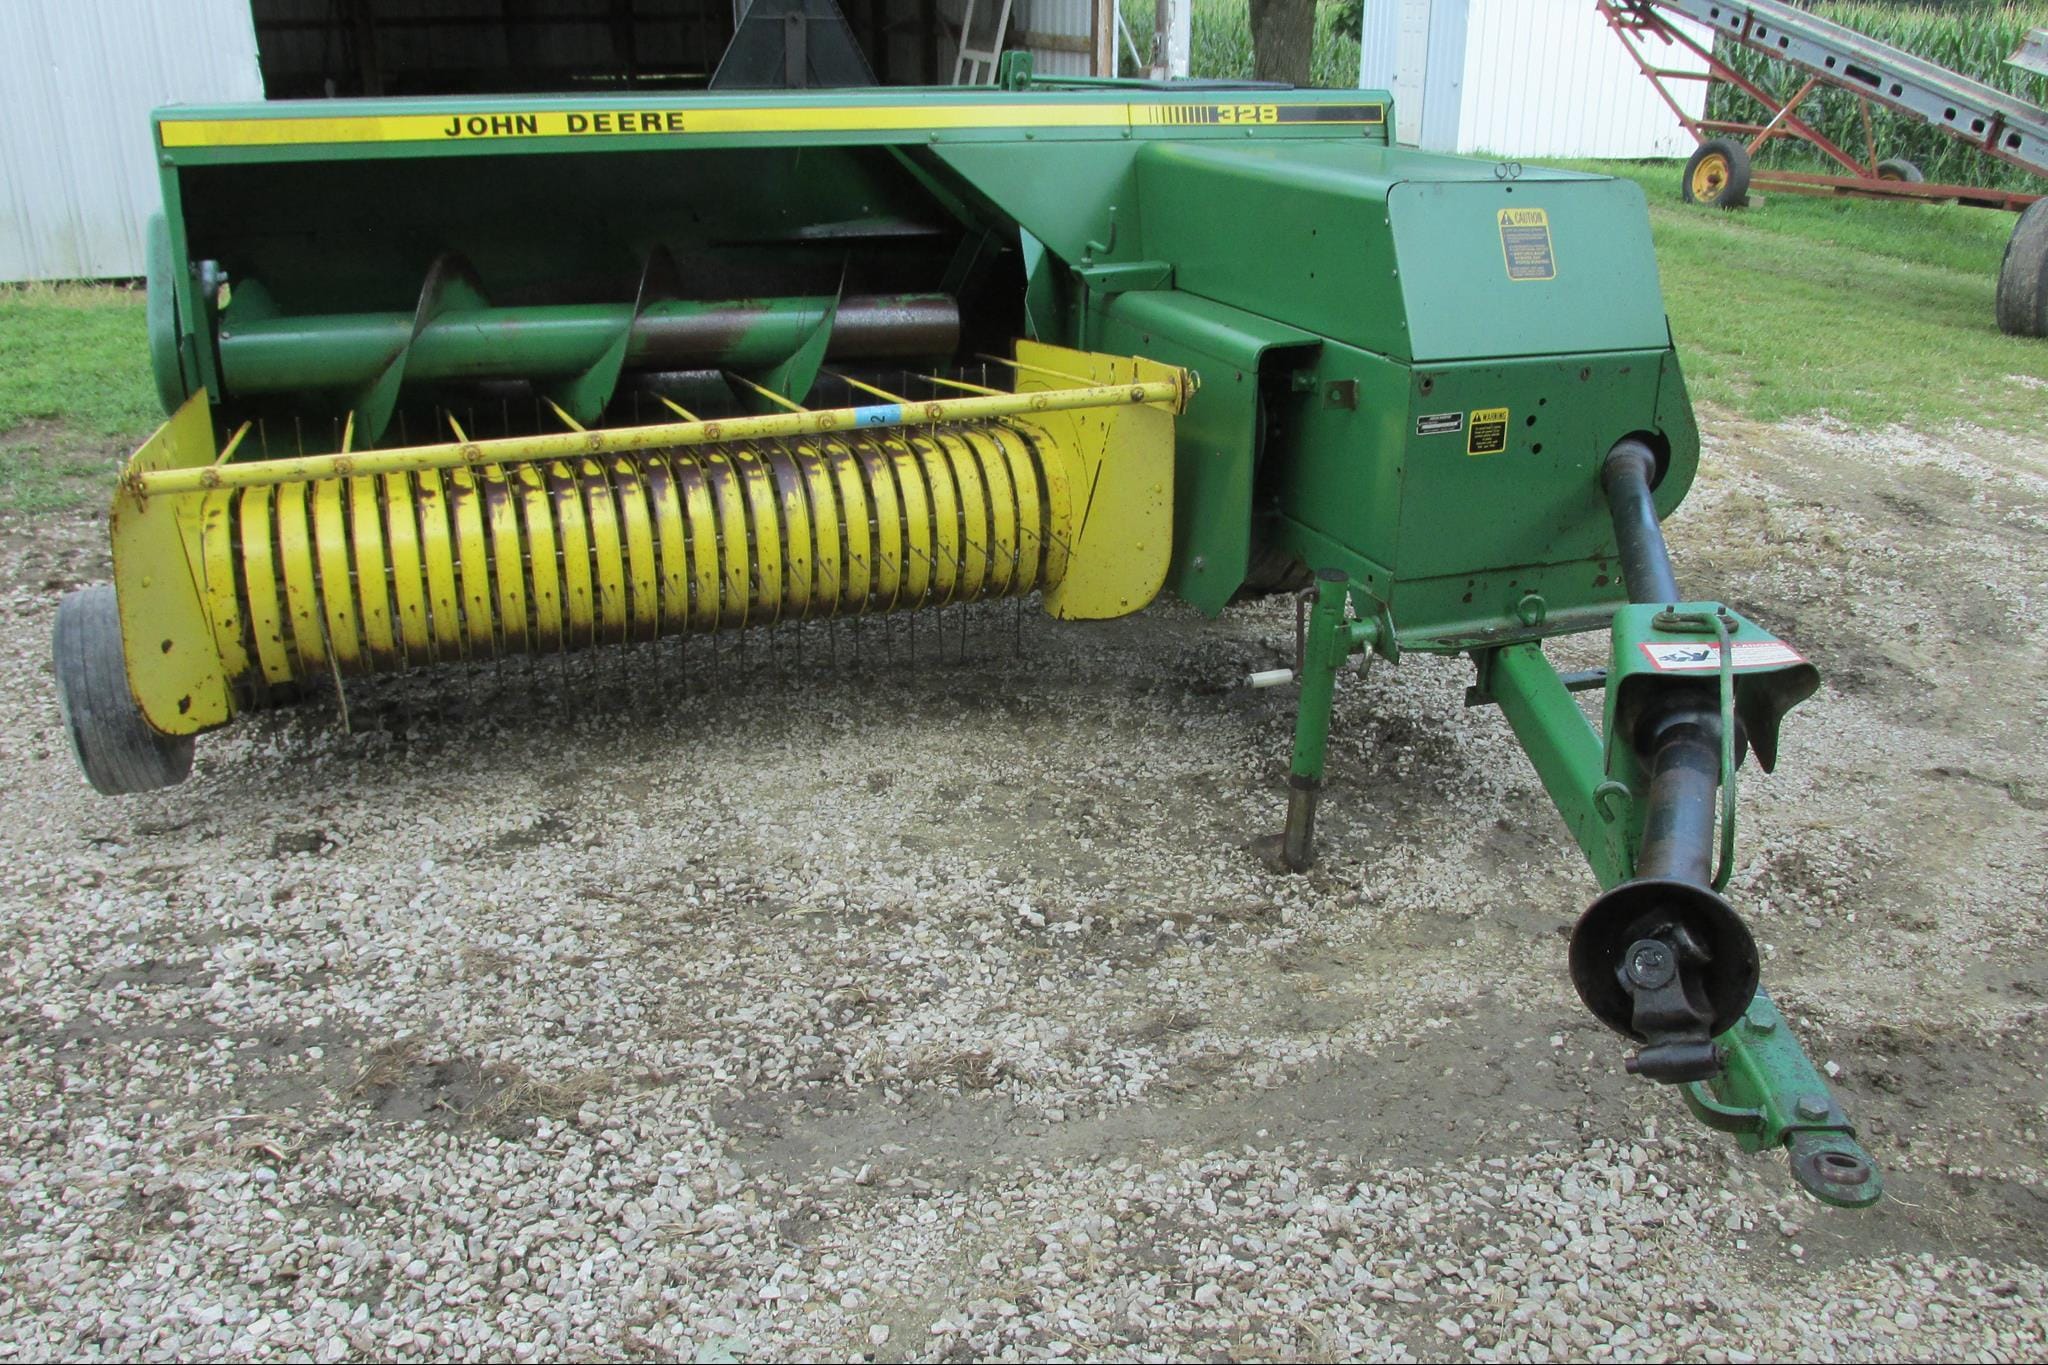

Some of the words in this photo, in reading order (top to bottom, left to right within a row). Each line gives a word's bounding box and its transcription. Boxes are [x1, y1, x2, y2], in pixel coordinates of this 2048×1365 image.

[1217, 104, 1278, 124] 328
[444, 115, 538, 136] JOHN
[567, 112, 685, 133] DEERE
[1514, 211, 1543, 224] CAUTION
[870, 415, 885, 423] 2
